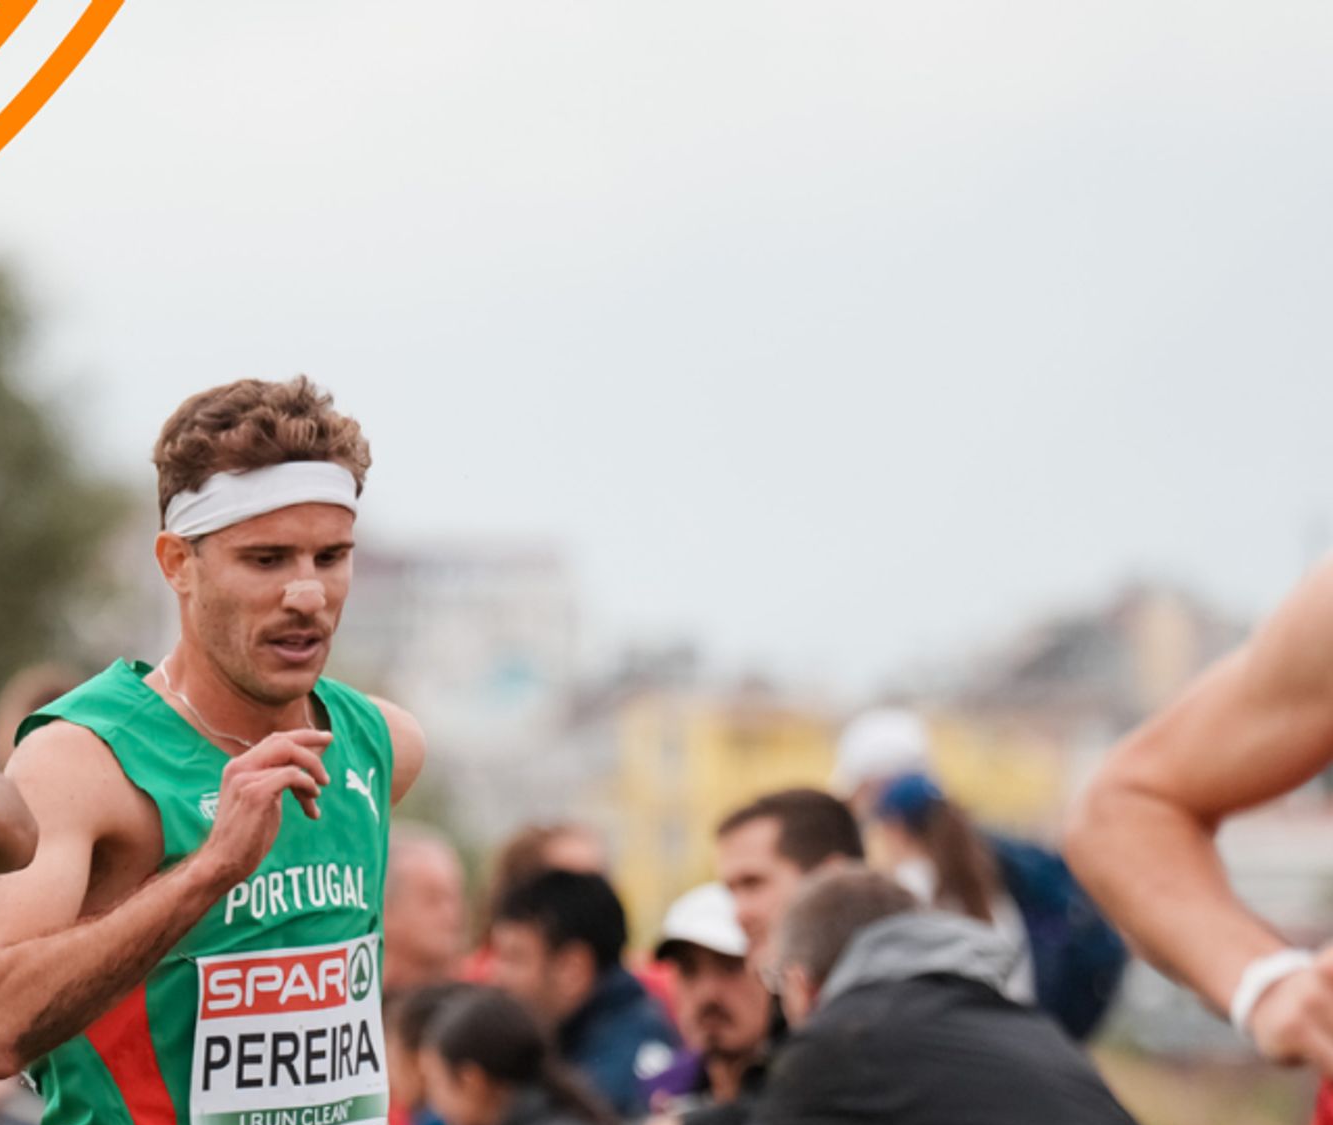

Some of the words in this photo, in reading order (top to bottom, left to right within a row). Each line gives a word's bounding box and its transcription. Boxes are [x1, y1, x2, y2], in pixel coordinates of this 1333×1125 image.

[224, 863, 368, 925] PORTUGAL
[207, 957, 346, 1010] SPAR
[202, 1020, 380, 1092] PEREIRA
